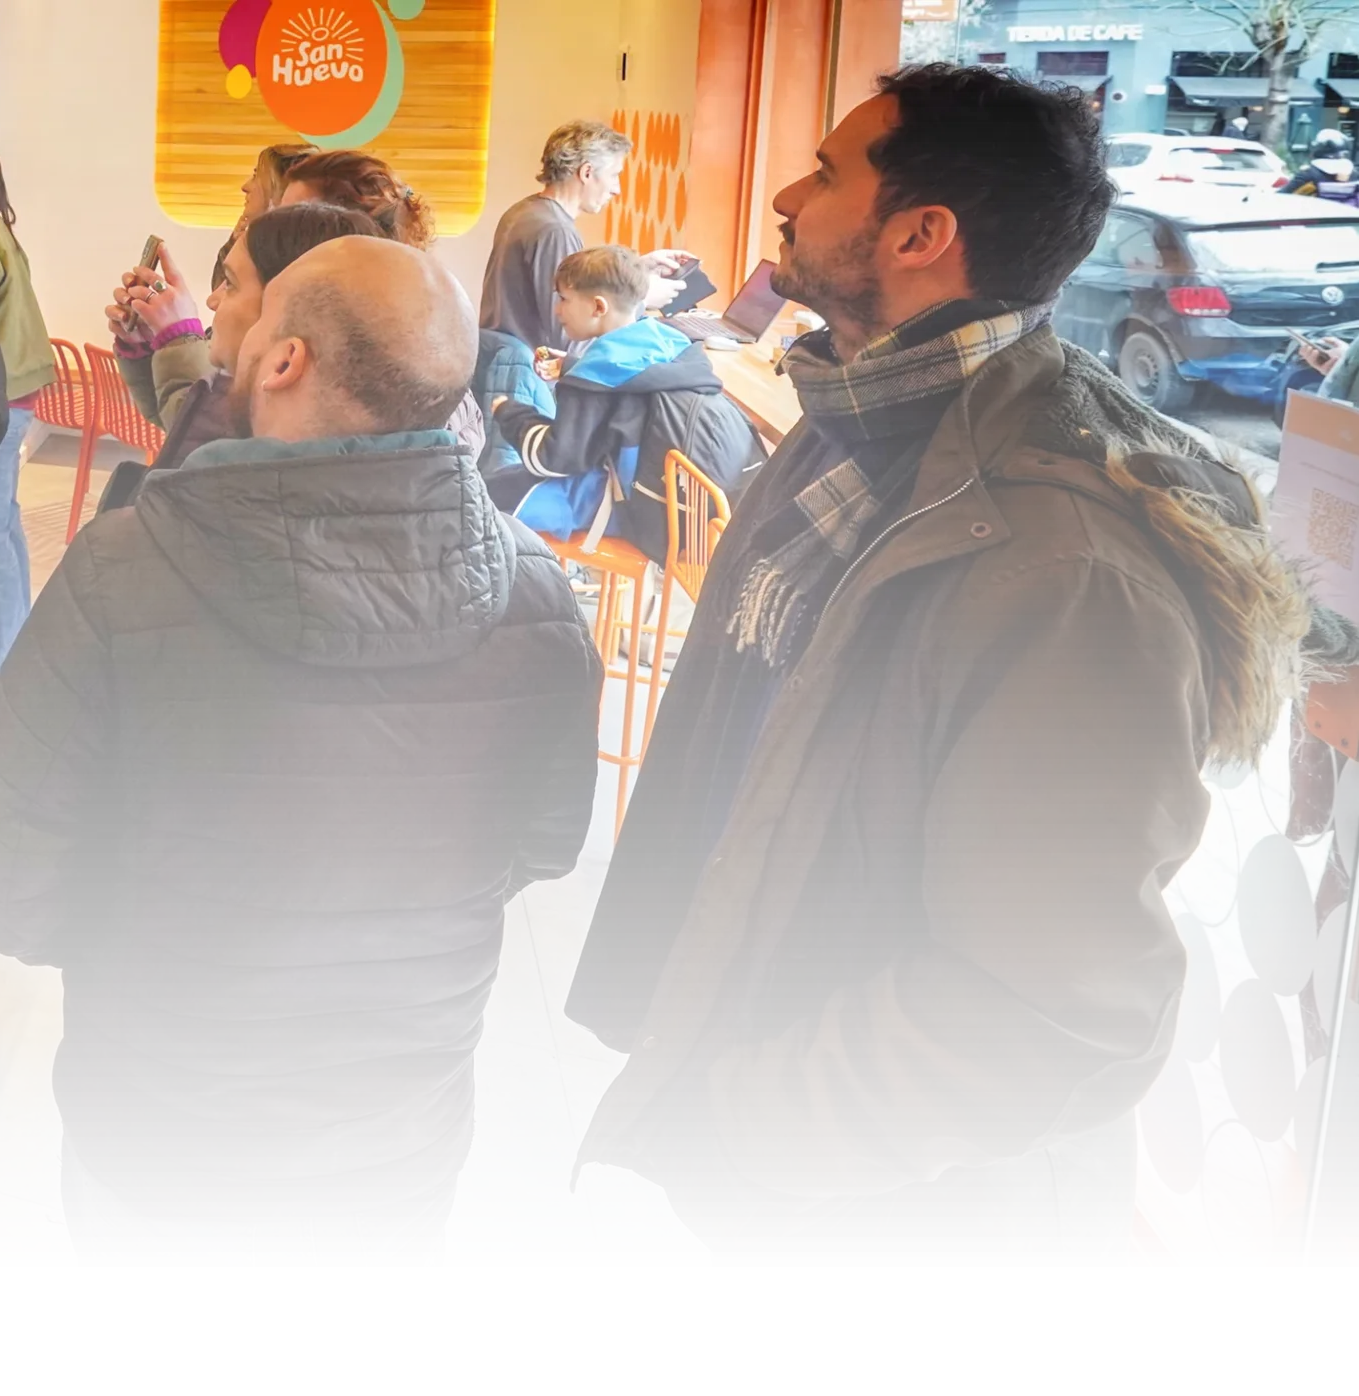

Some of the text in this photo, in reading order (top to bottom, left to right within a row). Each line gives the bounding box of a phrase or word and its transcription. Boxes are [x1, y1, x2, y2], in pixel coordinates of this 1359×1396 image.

[1067, 25, 1092, 41] DE
[295, 41, 343, 67] San
[272, 54, 364, 87] Huevo
